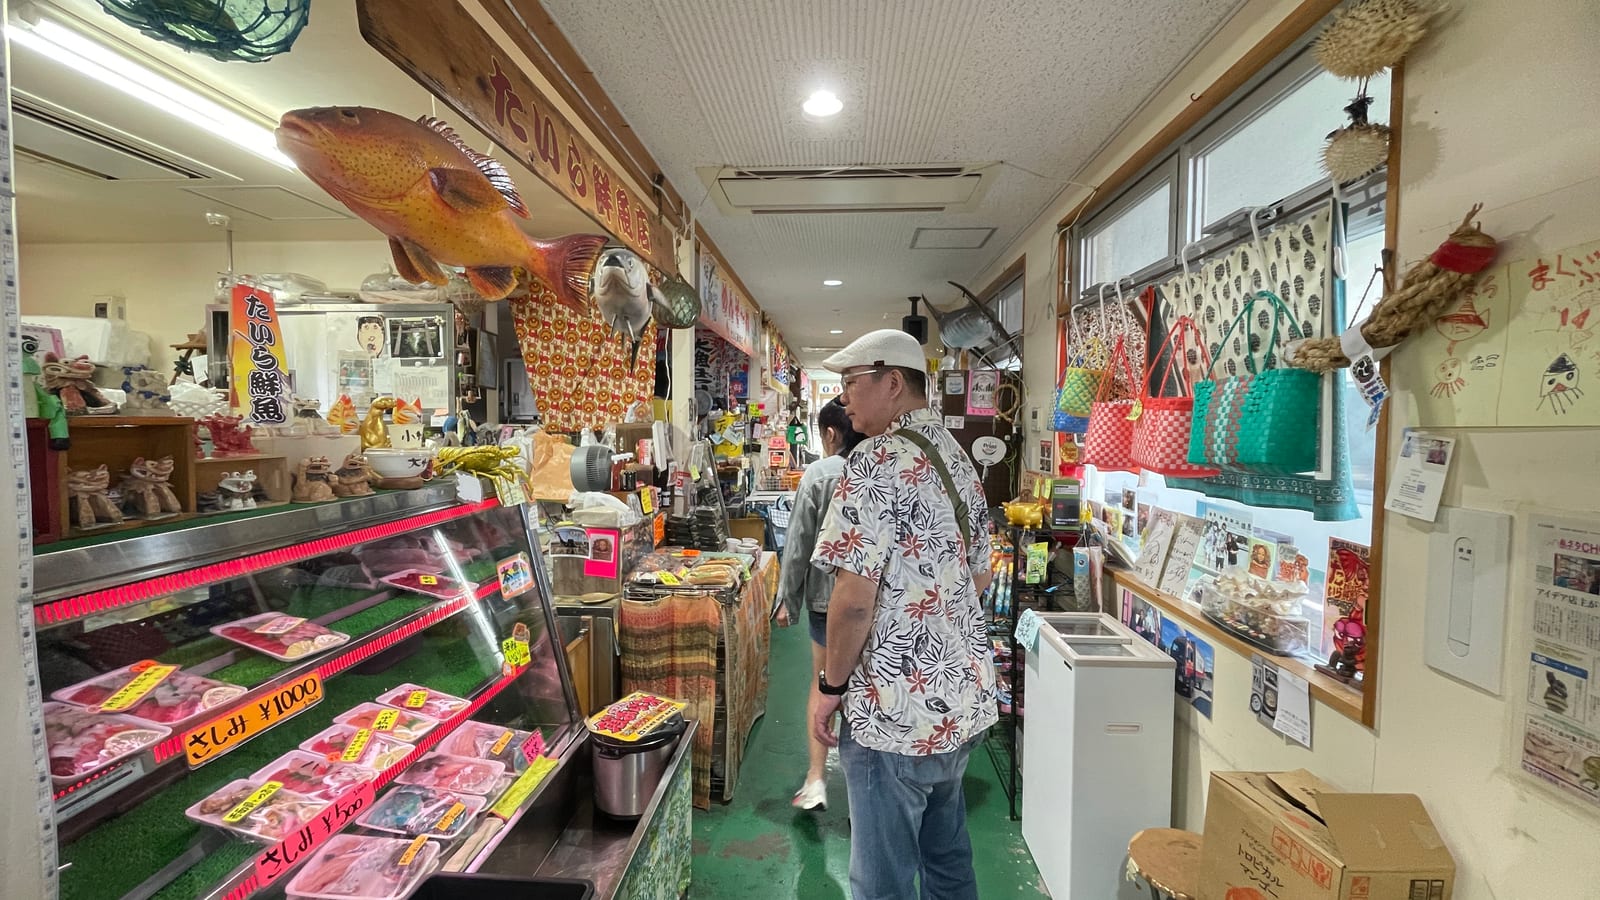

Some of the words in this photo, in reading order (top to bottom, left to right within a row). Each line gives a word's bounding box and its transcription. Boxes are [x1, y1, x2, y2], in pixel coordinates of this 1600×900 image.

[488, 56, 651, 255] たいら鮮魚店
[245, 295, 285, 423] たいら鮮魚
[188, 714, 249, 759] さしみ
[258, 678, 317, 721] ¥1000
[260, 826, 316, 879] さしみ
[321, 798, 363, 833] ¥500
[1238, 843, 1284, 887] トロピカル
[1240, 862, 1279, 898] マンゴー
